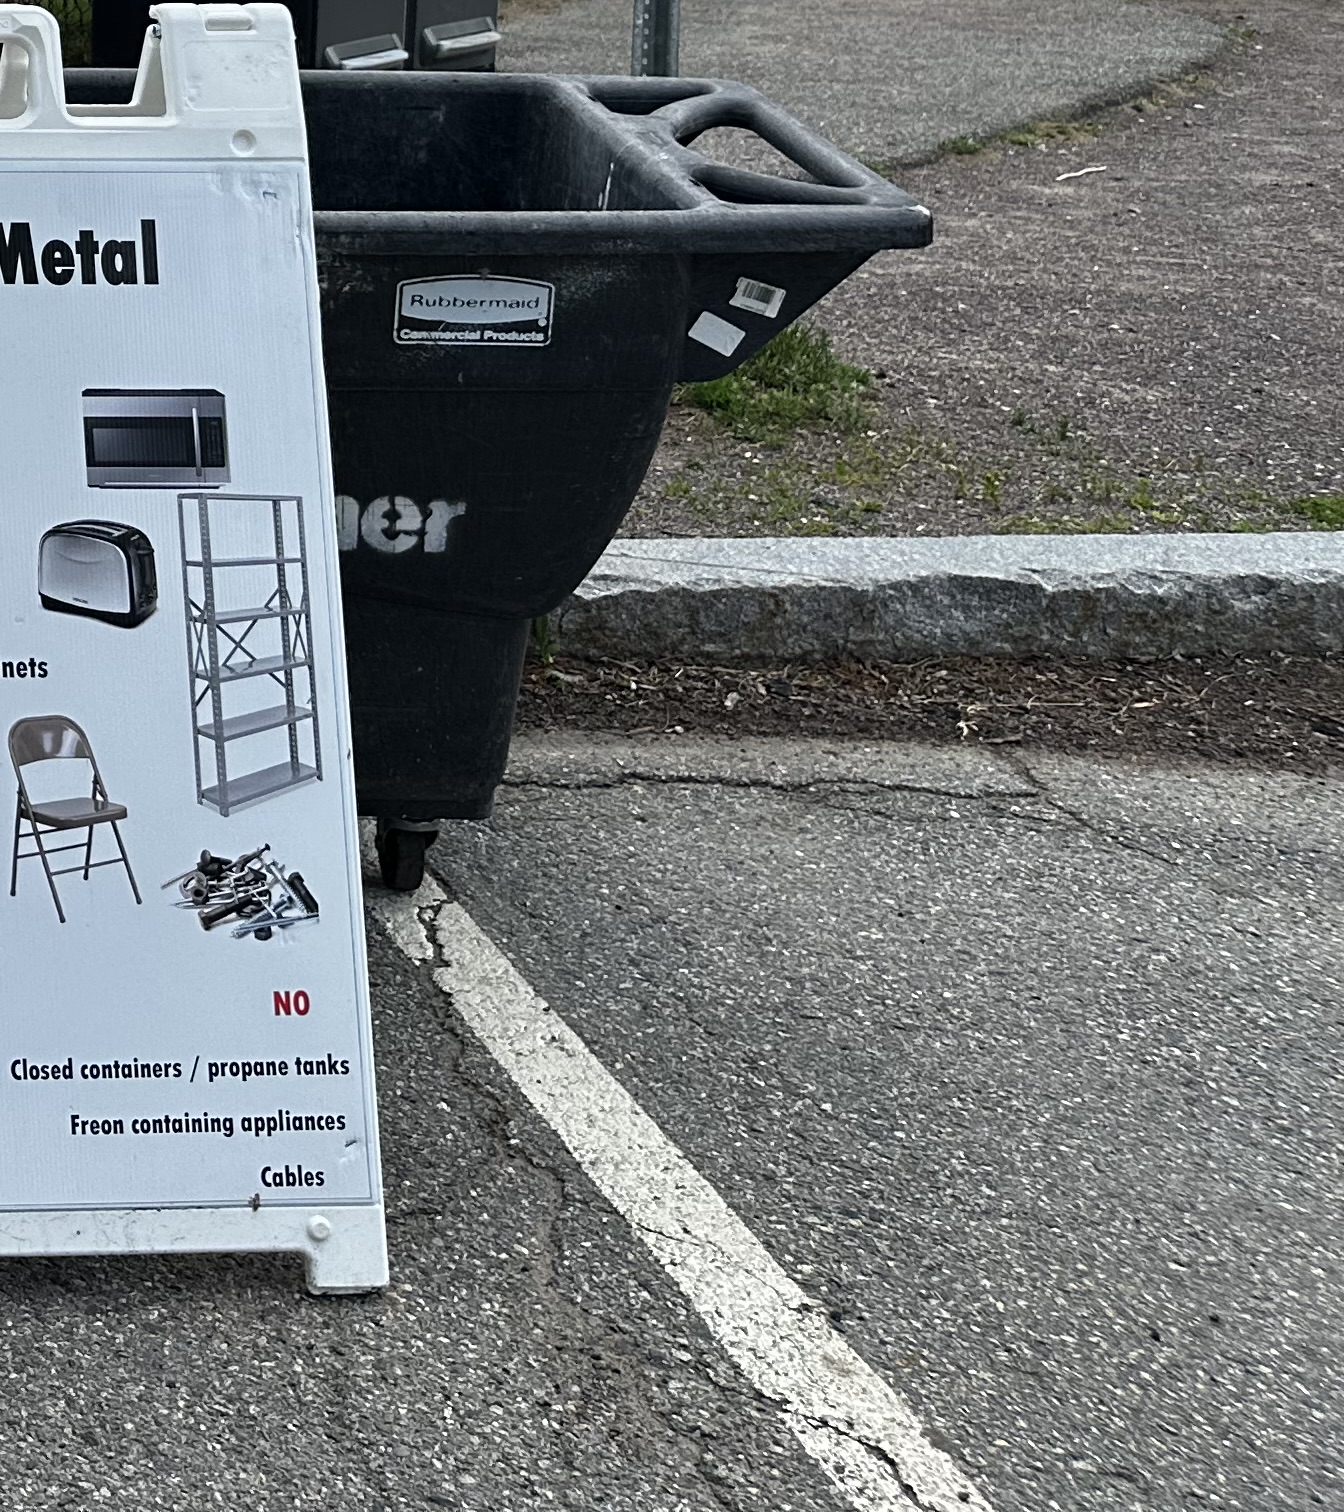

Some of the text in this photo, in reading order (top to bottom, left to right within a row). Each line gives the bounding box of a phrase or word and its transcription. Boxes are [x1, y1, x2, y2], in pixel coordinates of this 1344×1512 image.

[410, 294, 541, 309] Rubbermaid
[399, 328, 545, 341] Commercial Products
[273, 990, 310, 1016] NO
[10, 1054, 350, 1083] Closed containers / propane tanks
[70, 1110, 346, 1137] Freon containing appliances
[260, 1166, 325, 1187] Cables
